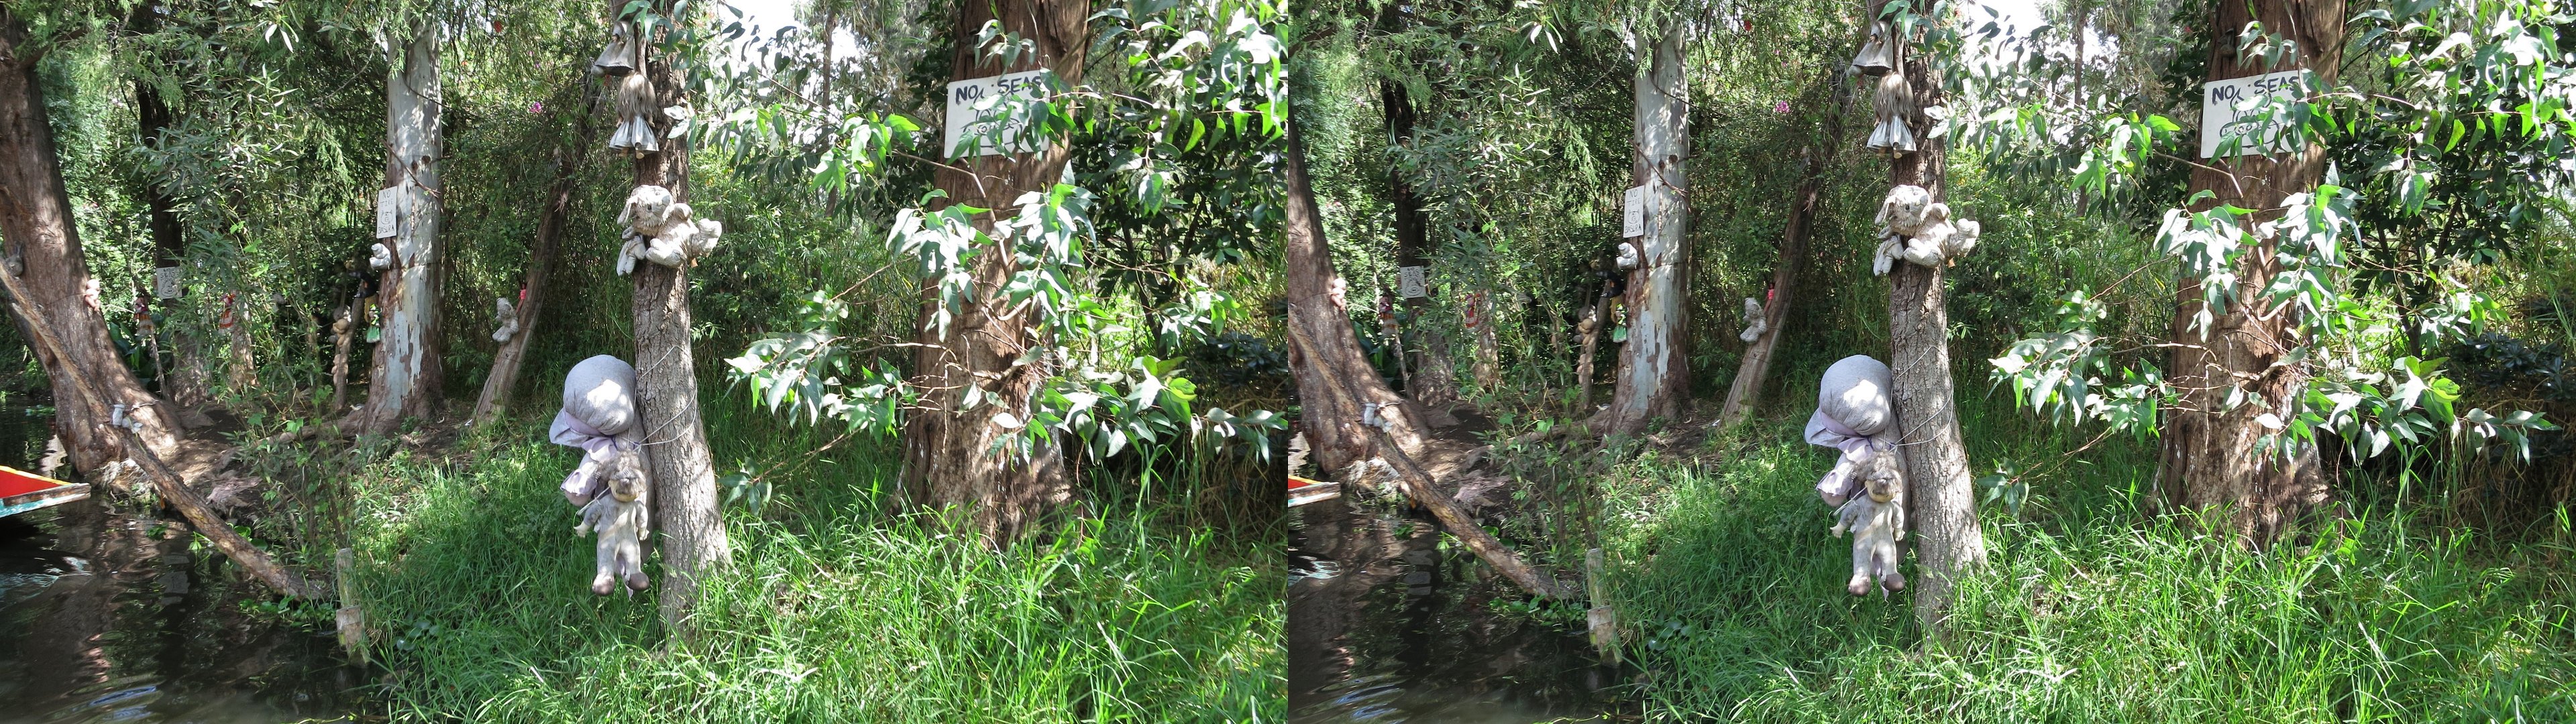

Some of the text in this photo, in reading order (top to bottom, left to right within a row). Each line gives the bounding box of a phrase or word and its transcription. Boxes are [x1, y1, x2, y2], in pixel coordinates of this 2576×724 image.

[955, 85, 979, 105] NO
[2212, 85, 2235, 105] NO
[383, 190, 391, 198] NO
[1629, 189, 1638, 198] NO
[378, 225, 395, 234] BASURA
[1624, 224, 1642, 233] BASURA
